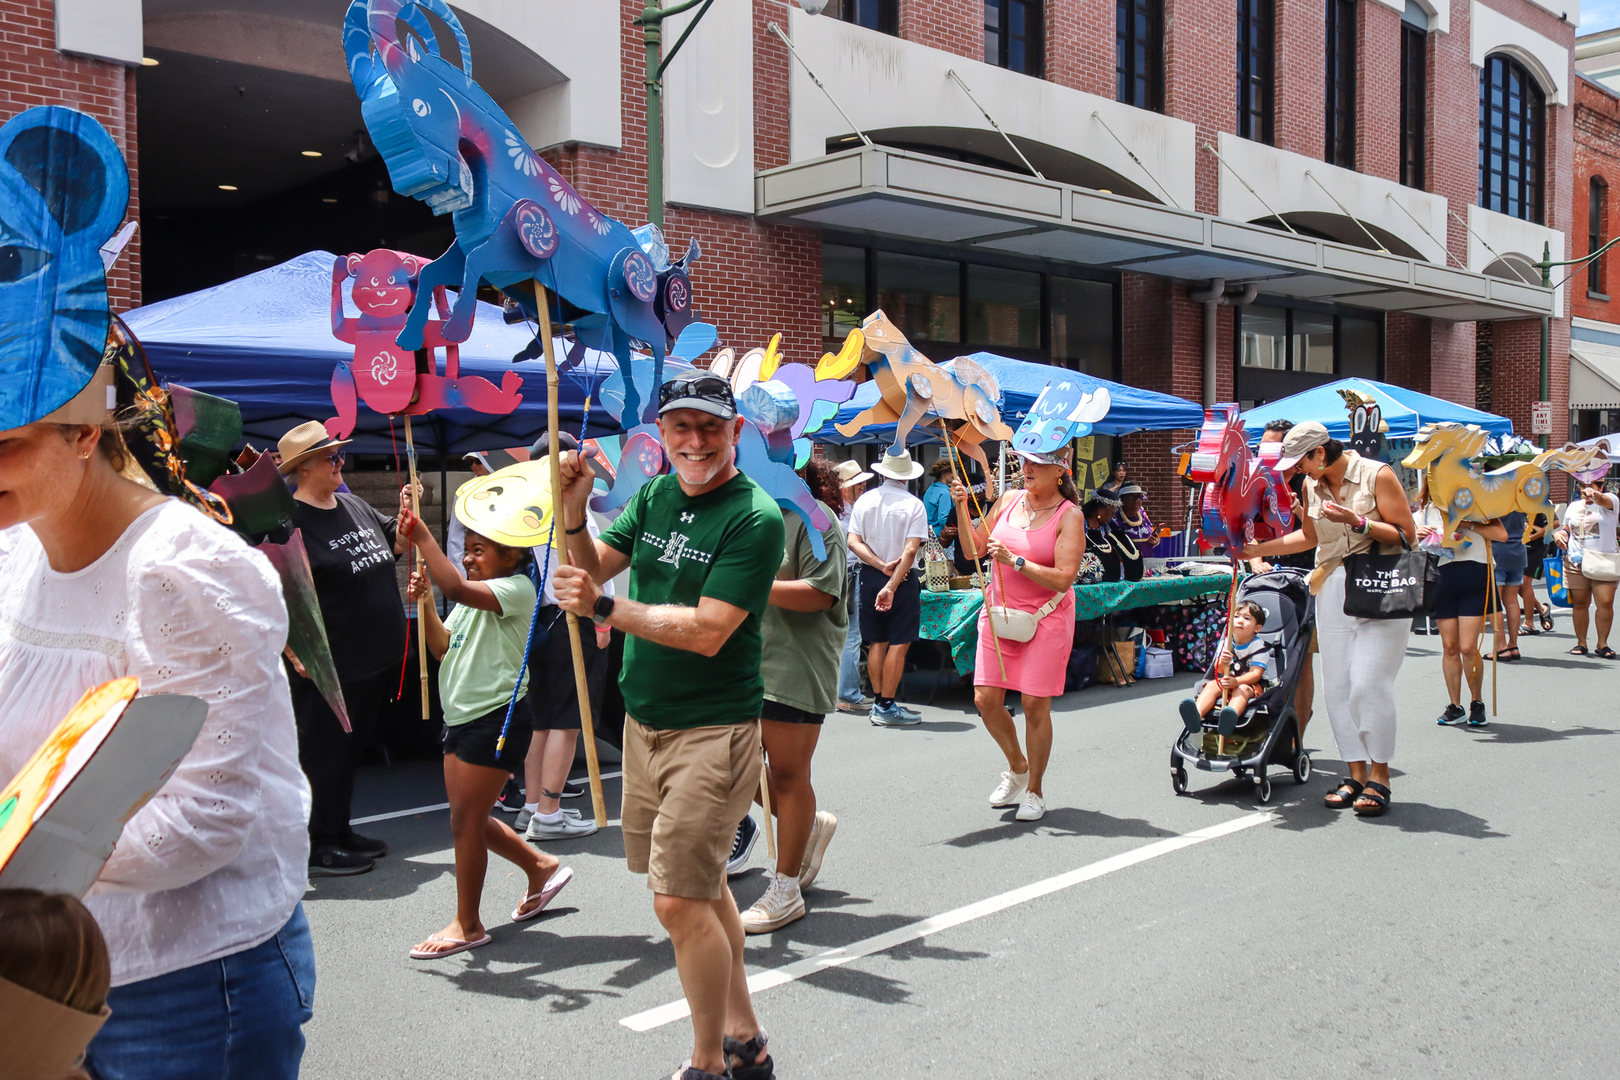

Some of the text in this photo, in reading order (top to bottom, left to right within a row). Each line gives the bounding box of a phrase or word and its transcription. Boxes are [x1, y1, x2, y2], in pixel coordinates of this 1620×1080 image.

[1376, 569, 1400, 579] THE
[1355, 576, 1417, 588] TOTE BAG
